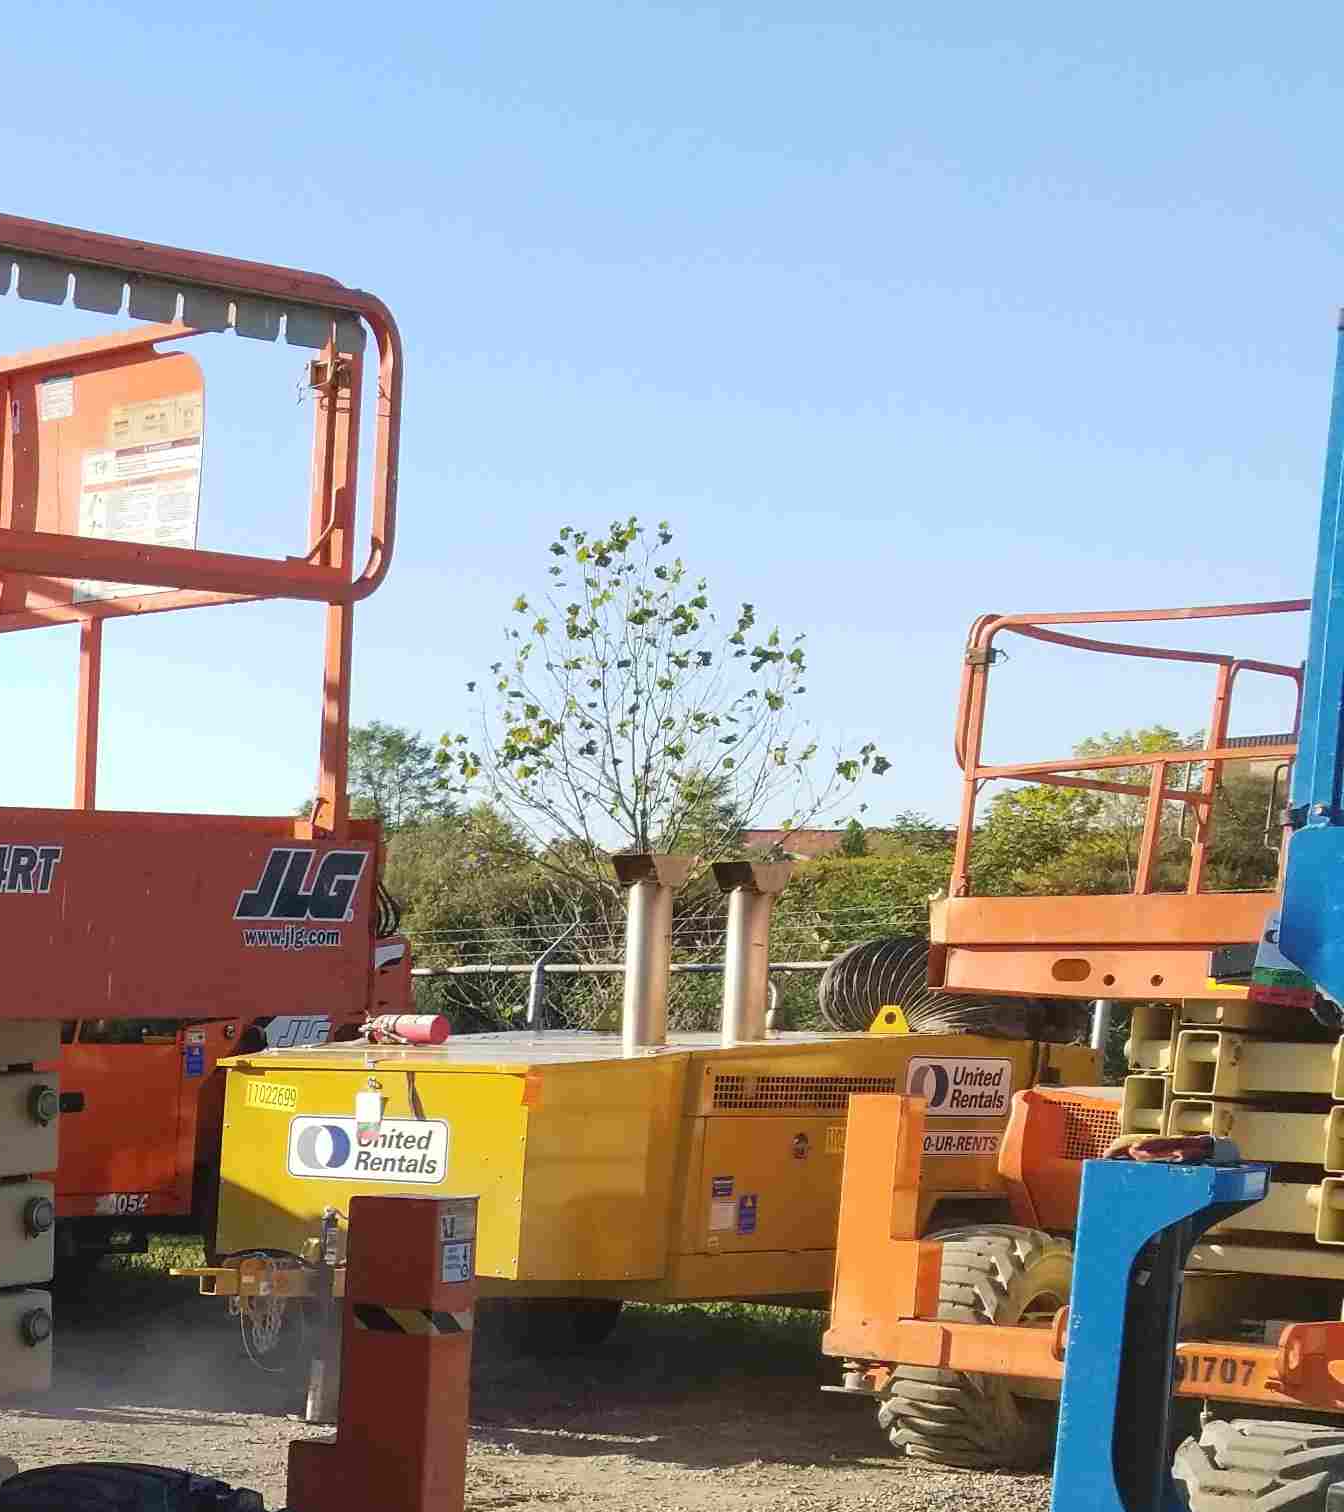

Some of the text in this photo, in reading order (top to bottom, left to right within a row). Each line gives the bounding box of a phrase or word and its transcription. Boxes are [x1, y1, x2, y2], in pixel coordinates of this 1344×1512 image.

[233, 848, 369, 921] JLG
[243, 926, 340, 949] www.jlg.com
[953, 1066, 1003, 1087] United
[950, 1089, 1004, 1109] Rentals
[923, 1135, 999, 1152] 0-UR-RENTS
[354, 1151, 437, 1175] Rentals
